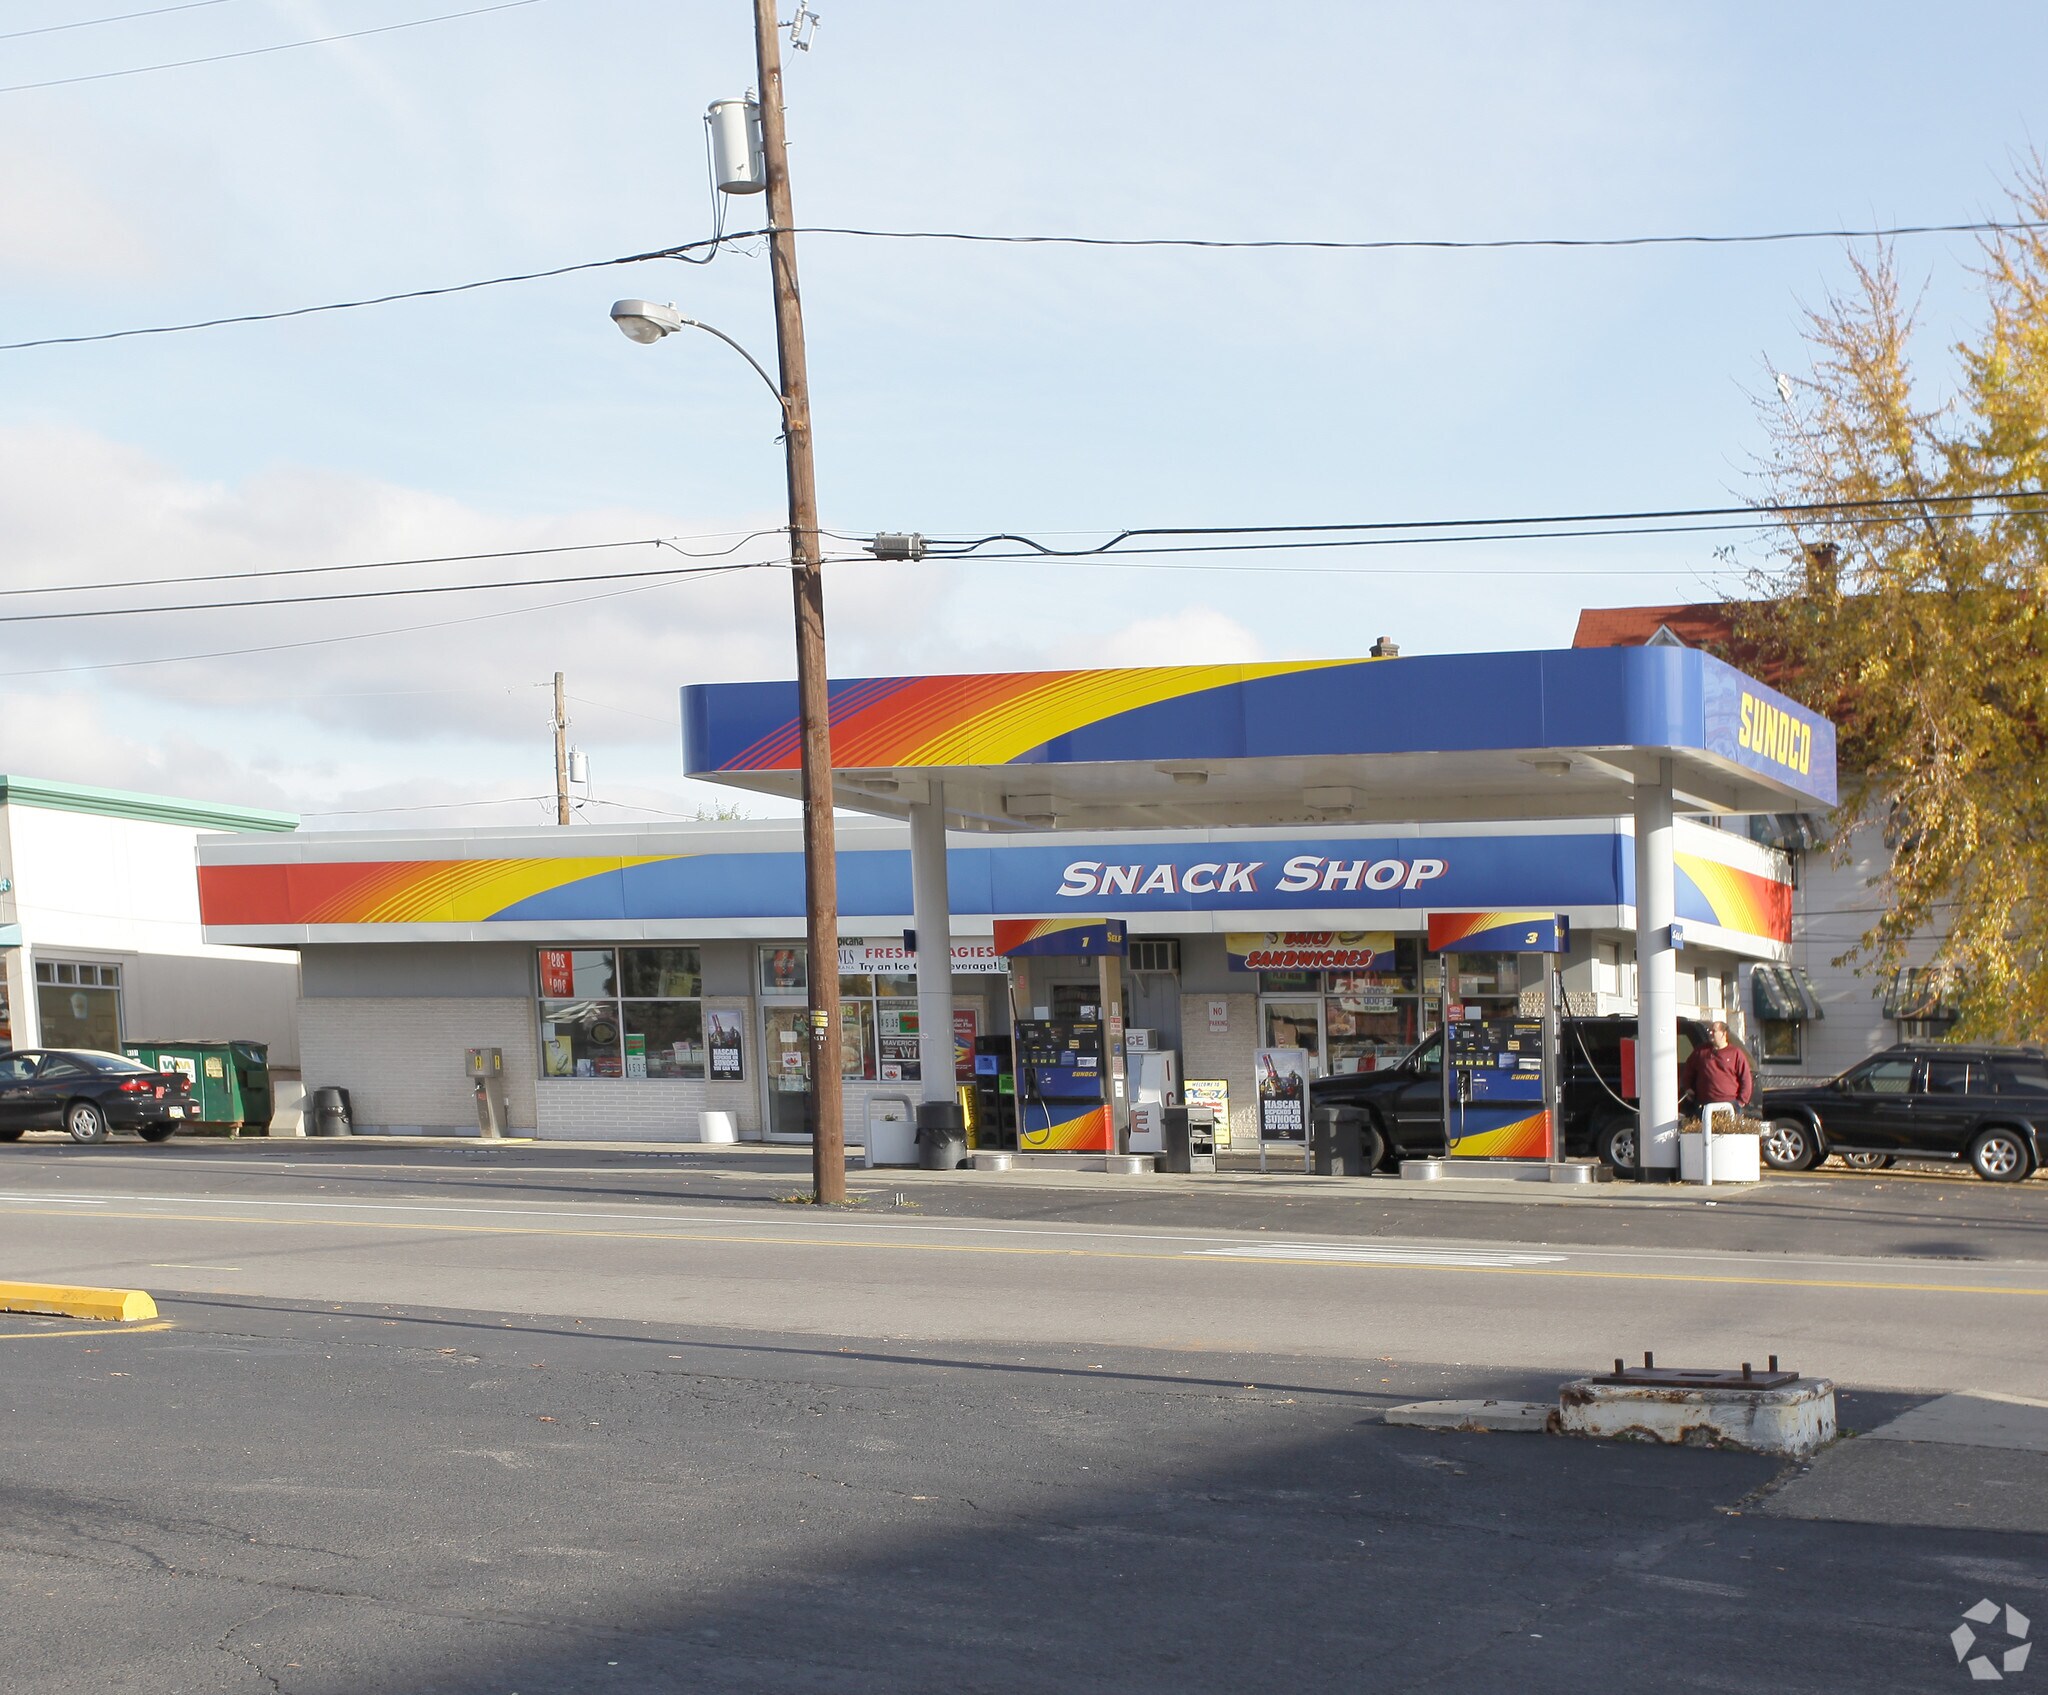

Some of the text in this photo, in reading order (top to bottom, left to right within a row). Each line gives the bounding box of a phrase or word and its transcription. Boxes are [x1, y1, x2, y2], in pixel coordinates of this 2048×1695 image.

[1739, 691, 1811, 775] SUNOCO
[1056, 855, 1449, 896] SNACK SHOP
[838, 936, 864, 947] picana
[1082, 936, 1089, 947] 1
[1525, 932, 1538, 943] 3
[865, 946, 995, 959] FRESH AGIES
[1245, 949, 1376, 970] SANDWICHES
[859, 960, 998, 972] Try an Ice everage!
[1213, 1007, 1223, 1016] NO
[1127, 1036, 1144, 1046] CE
[1264, 1100, 1301, 1109] NASCAR
[1265, 1115, 1301, 1124] SUNOCO
